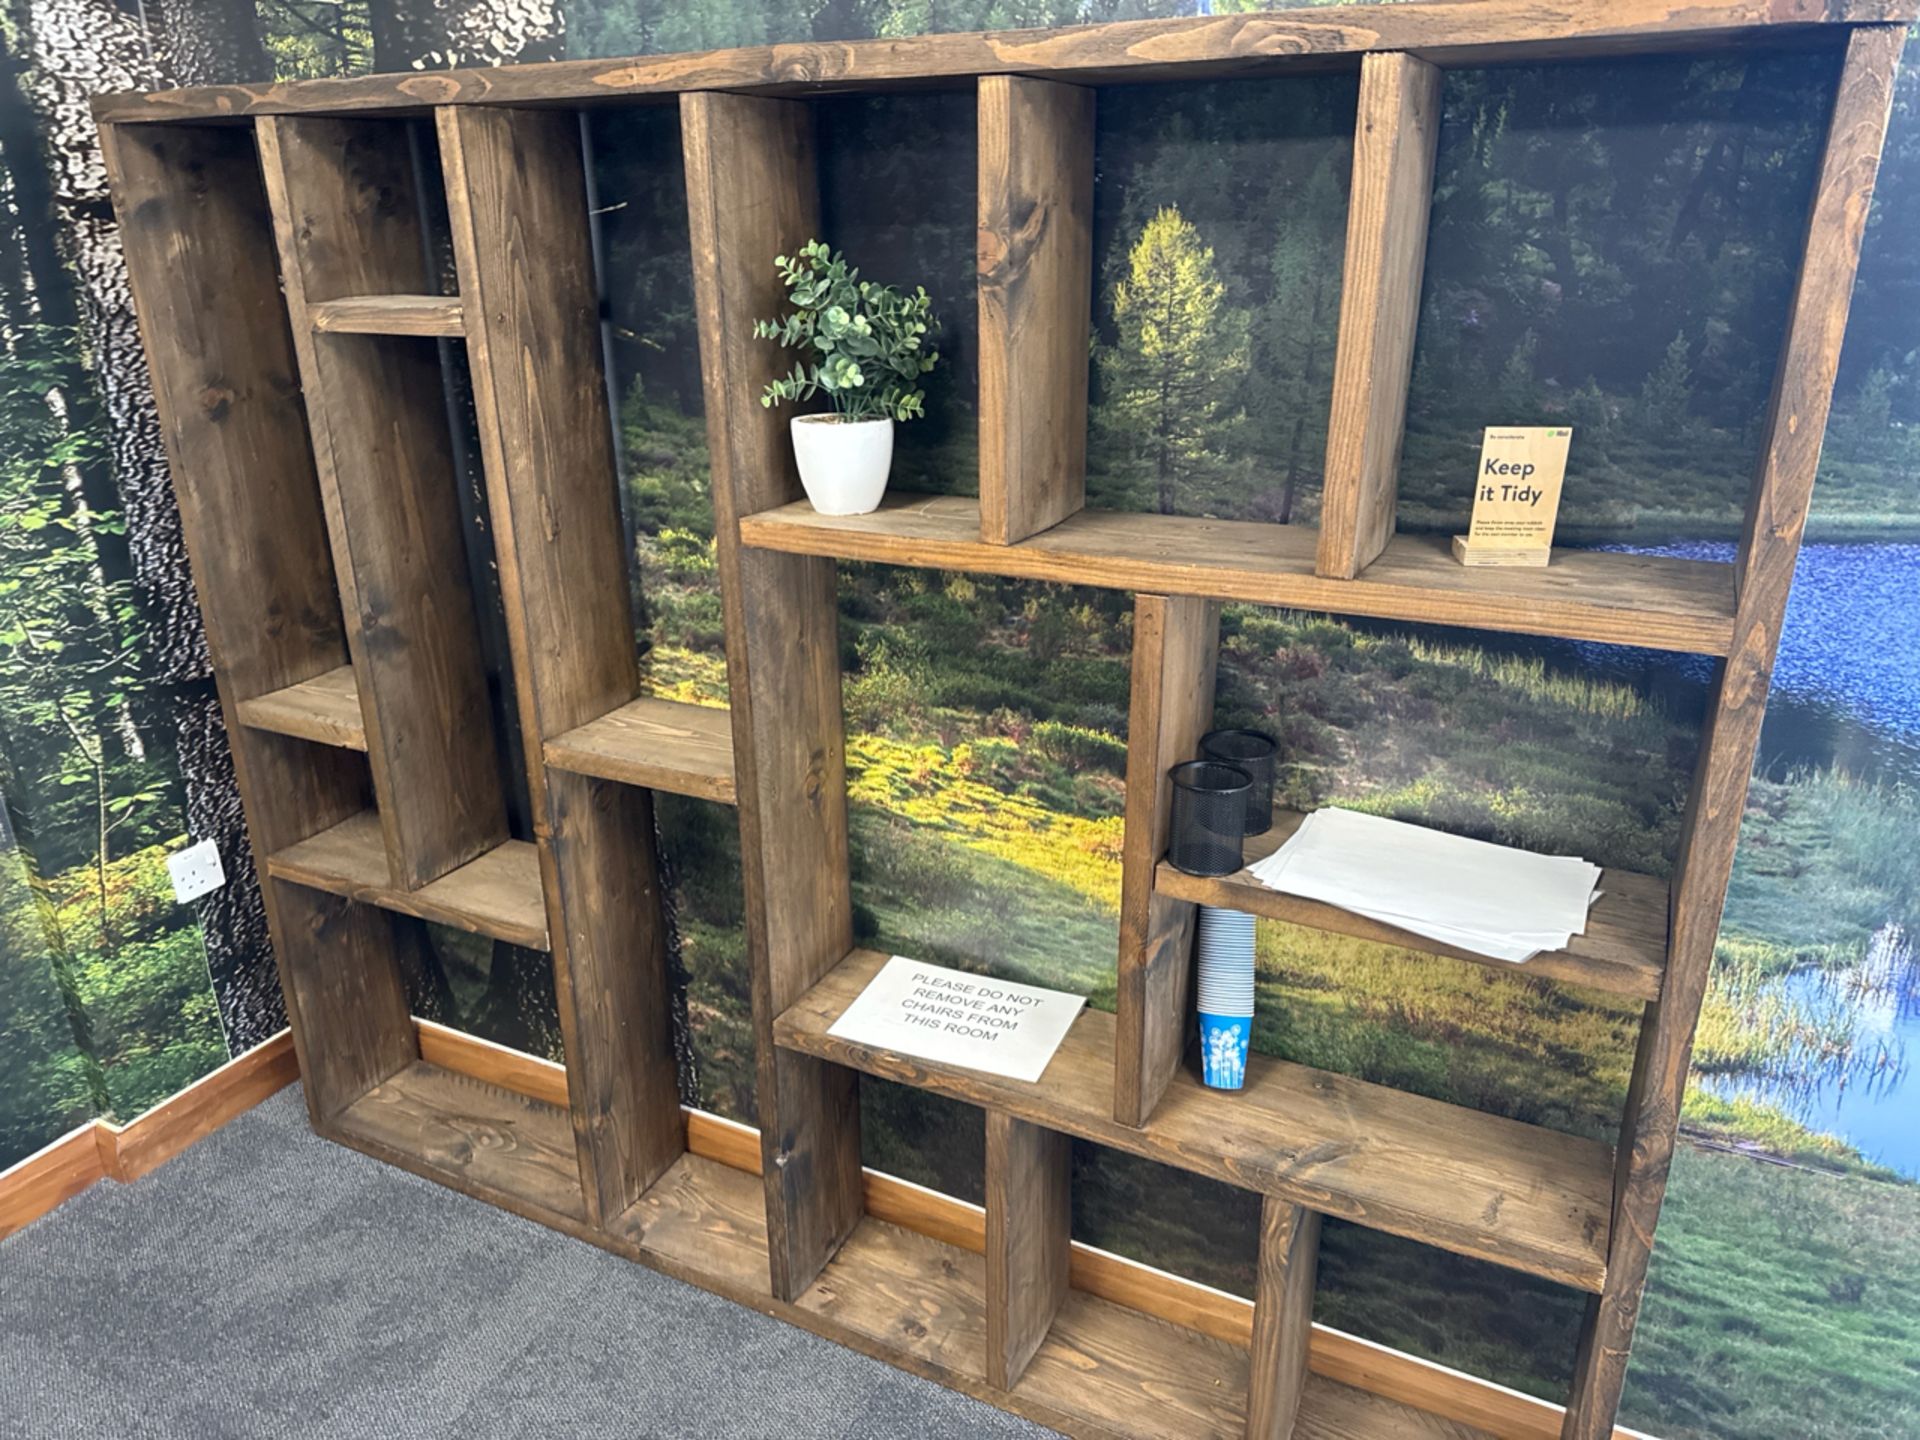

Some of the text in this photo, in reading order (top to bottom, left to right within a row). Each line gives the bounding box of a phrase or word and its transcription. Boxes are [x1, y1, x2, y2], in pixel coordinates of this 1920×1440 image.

[1485, 458, 1535, 480] Keep
[1480, 485, 1543, 507] it Tidy
[912, 973, 1045, 1008] PLEASE DO NOT
[913, 987, 1025, 1017] REMOVE ANY
[901, 998, 1019, 1031] CHAIRS FROM
[903, 1012, 999, 1041] THIS ROOM
